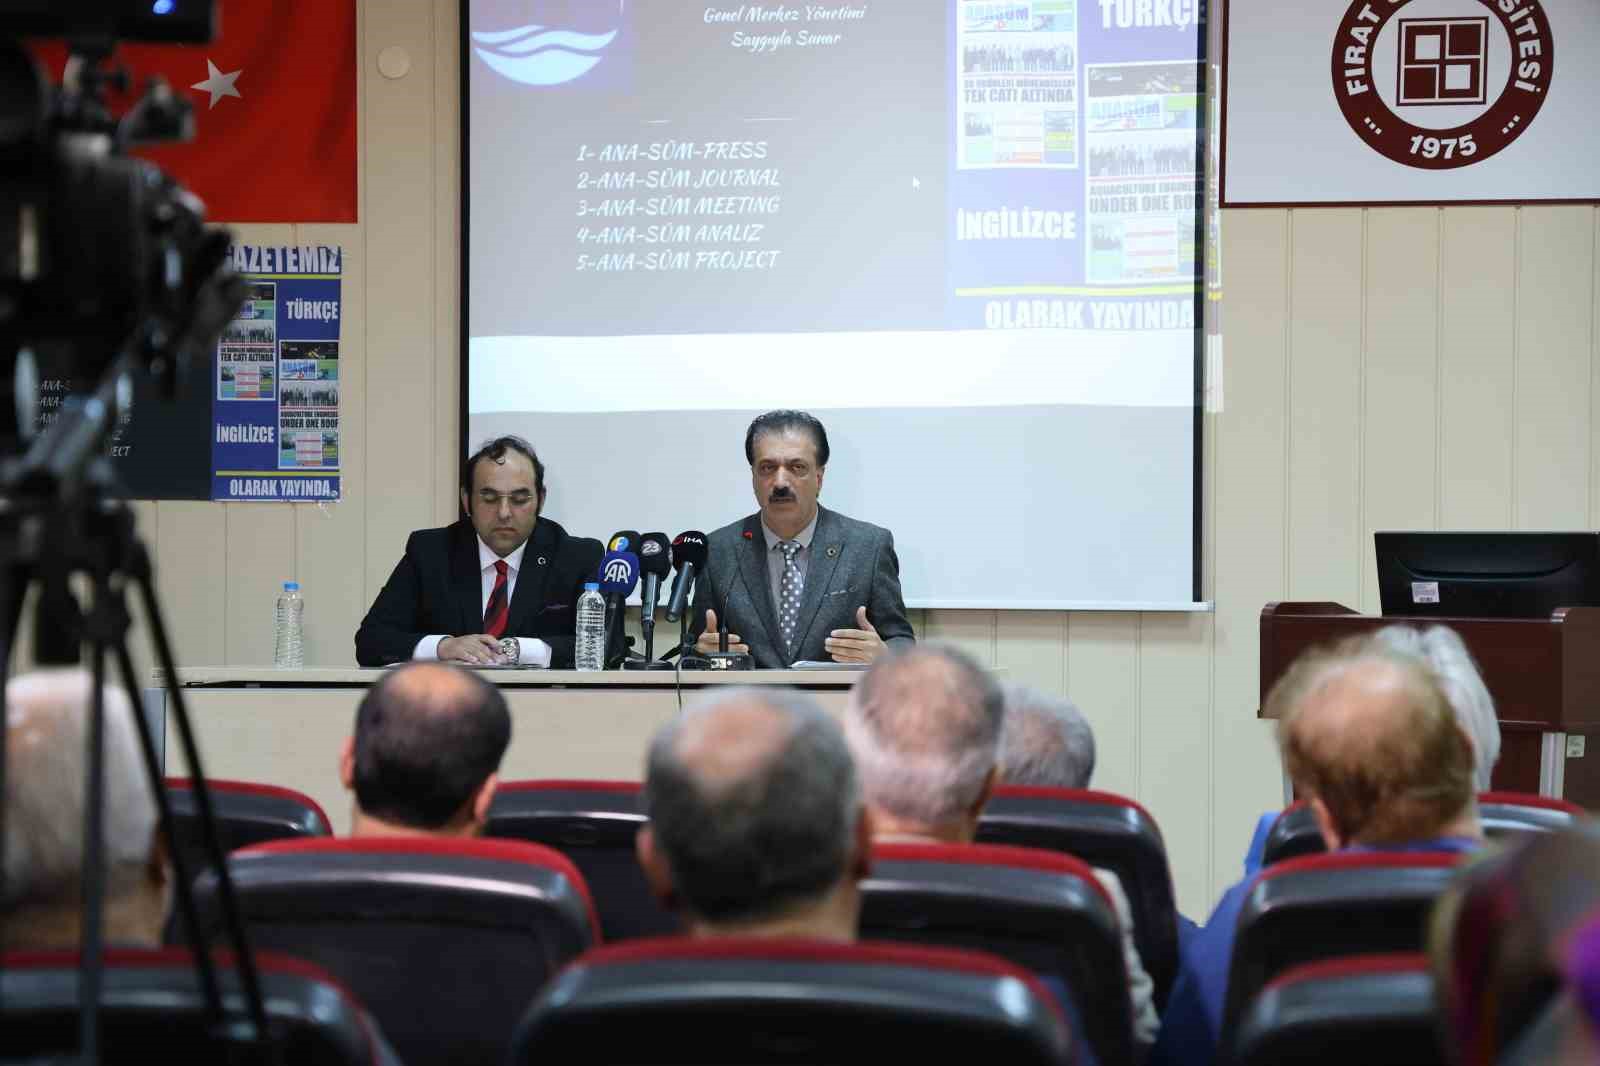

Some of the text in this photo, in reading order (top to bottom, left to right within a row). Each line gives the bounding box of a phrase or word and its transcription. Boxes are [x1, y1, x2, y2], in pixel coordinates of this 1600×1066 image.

[703, 5, 744, 23] Genel
[745, 5, 799, 22] Merkez
[796, 30, 841, 46] Sunar
[1344, 4, 1381, 96] FIRAT
[1409, 134, 1477, 159] 1975
[693, 168, 780, 188] JOURNAL
[694, 196, 780, 215] MEETING
[956, 205, 1077, 240] İNGİLİZCE
[695, 250, 781, 269] PROJECT
[286, 297, 338, 323] TÜRKÇE
[984, 301, 1084, 328] OLARAK
[216, 424, 274, 443] İNGİLİZCE
[230, 479, 277, 496] OLARAK
[642, 541, 660, 554] 23
[604, 564, 629, 584] AA
